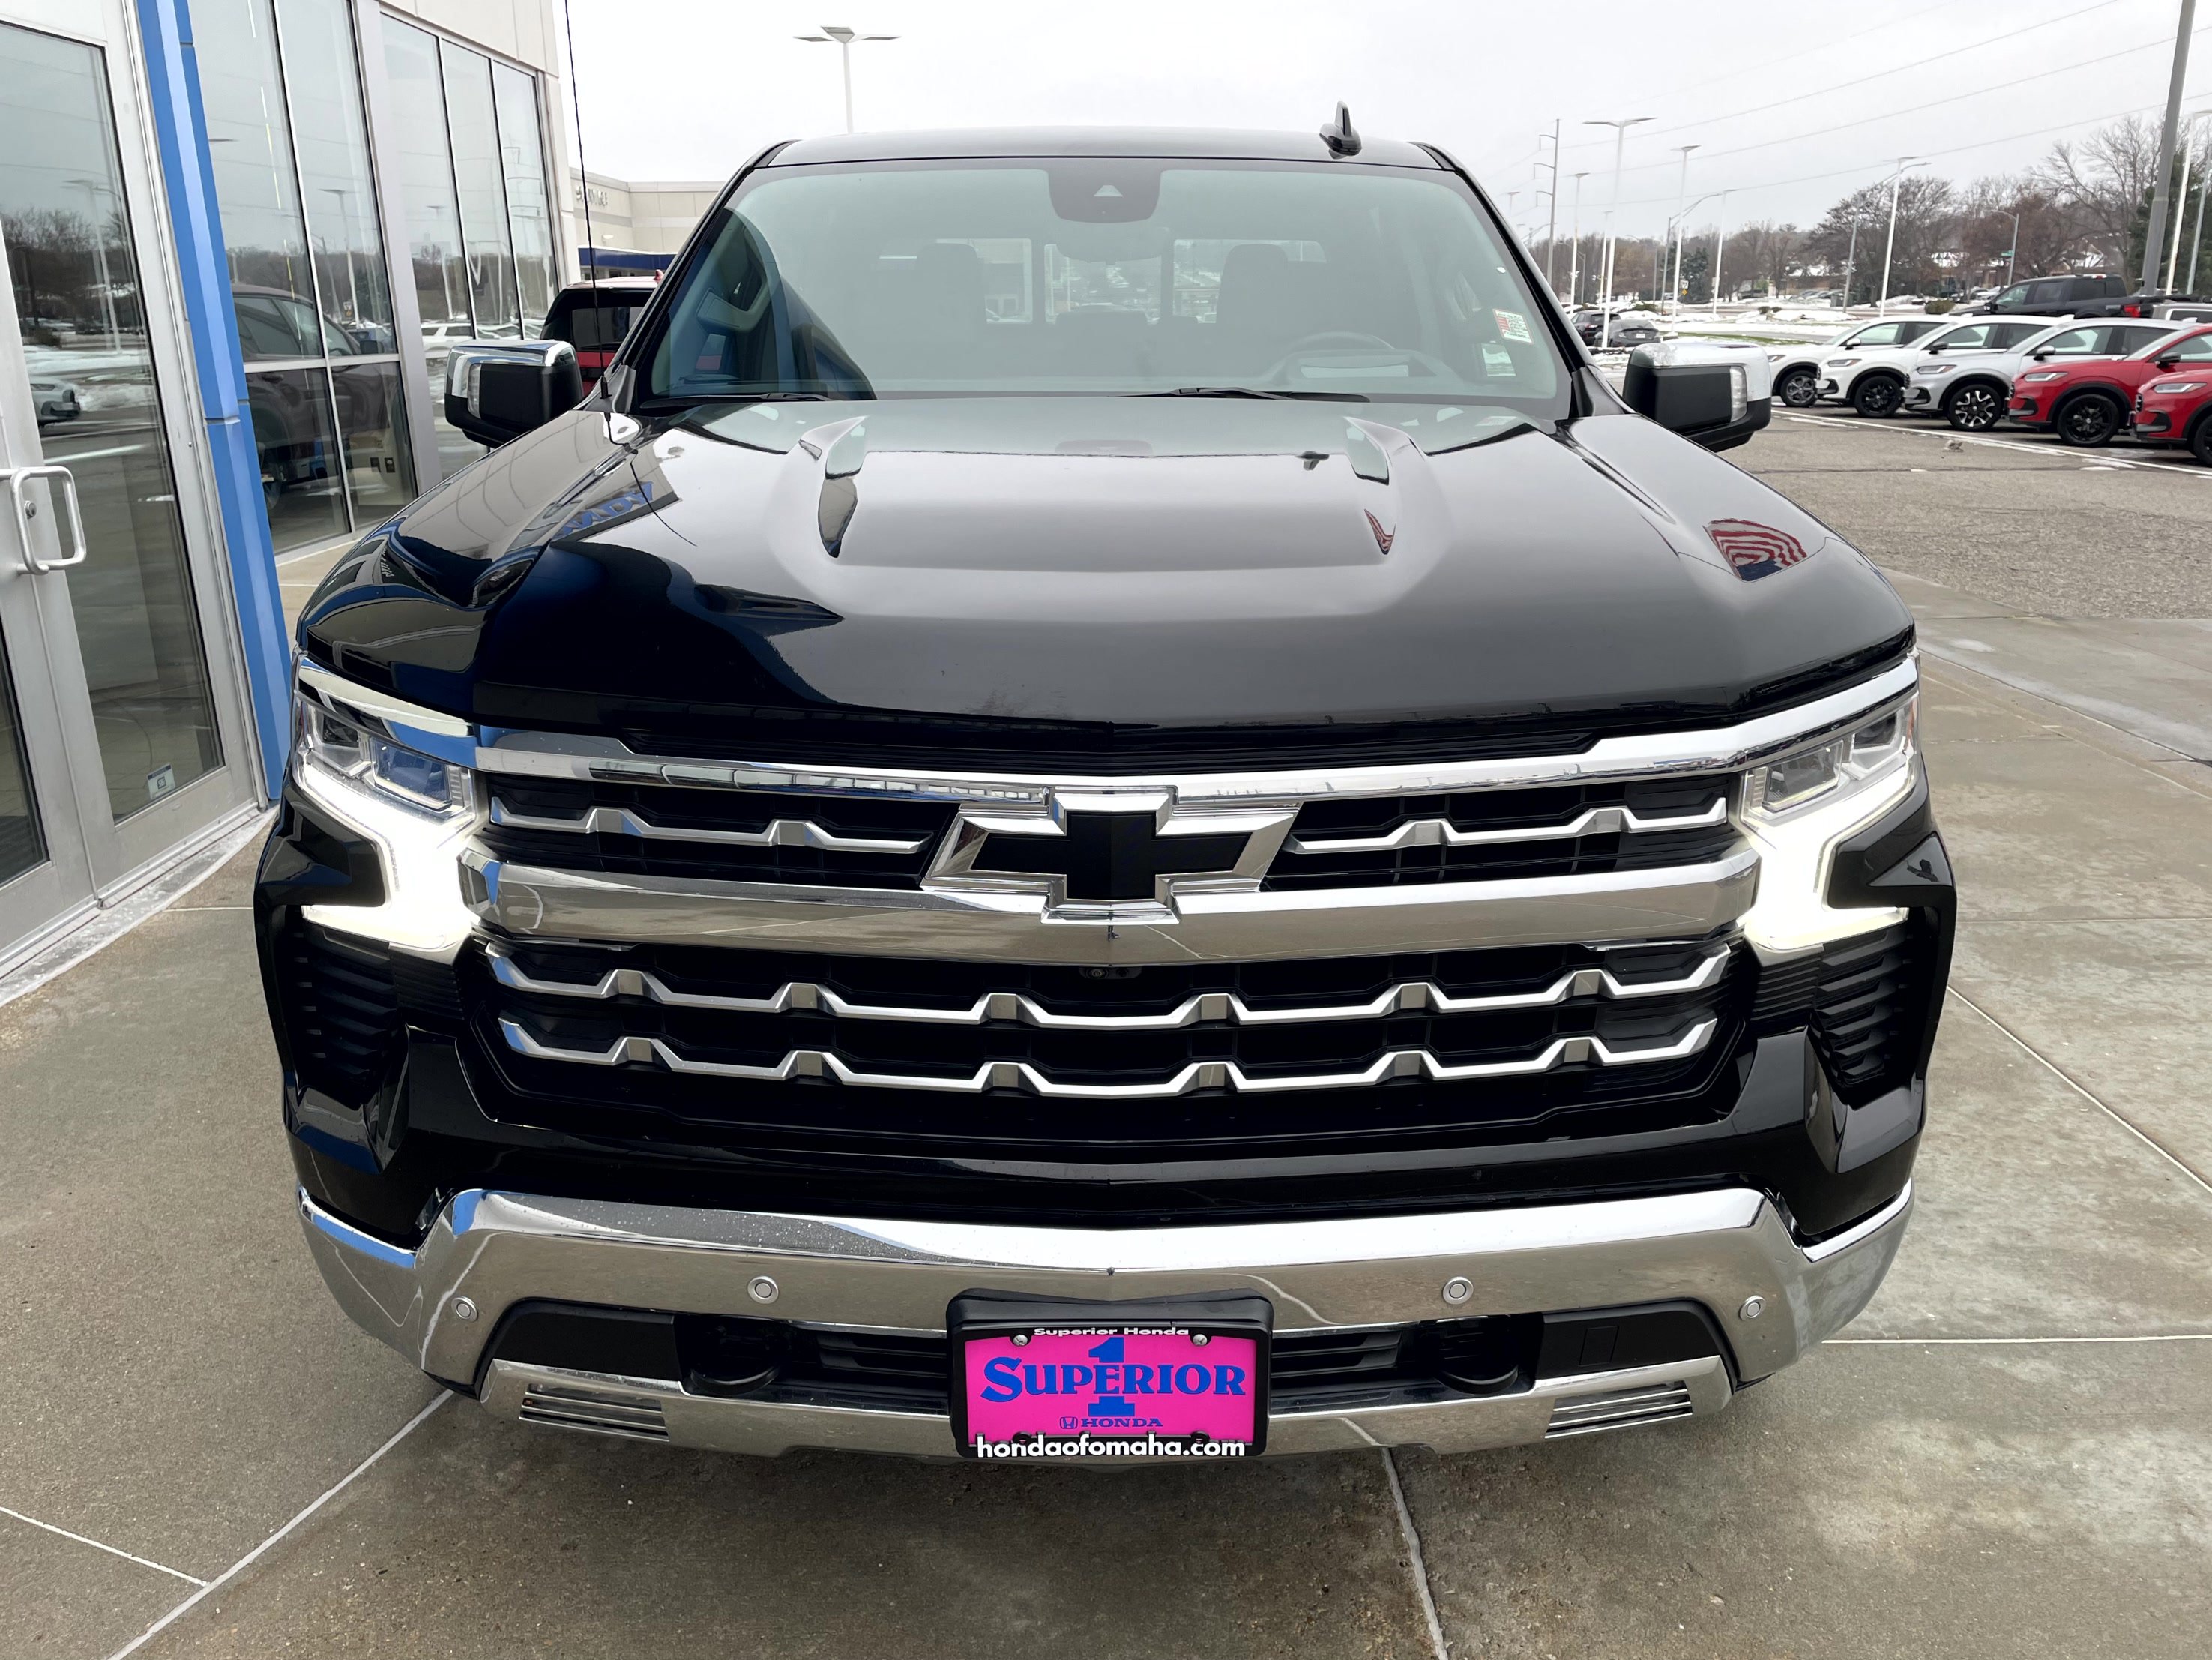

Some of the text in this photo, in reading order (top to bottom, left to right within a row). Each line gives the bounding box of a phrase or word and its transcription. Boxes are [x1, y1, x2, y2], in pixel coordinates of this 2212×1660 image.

[1034, 1327, 1189, 1337] Superior Honda
[1081, 1418, 1163, 1427] HONDA
[977, 1434, 1245, 1458] hondaofomaha.com
